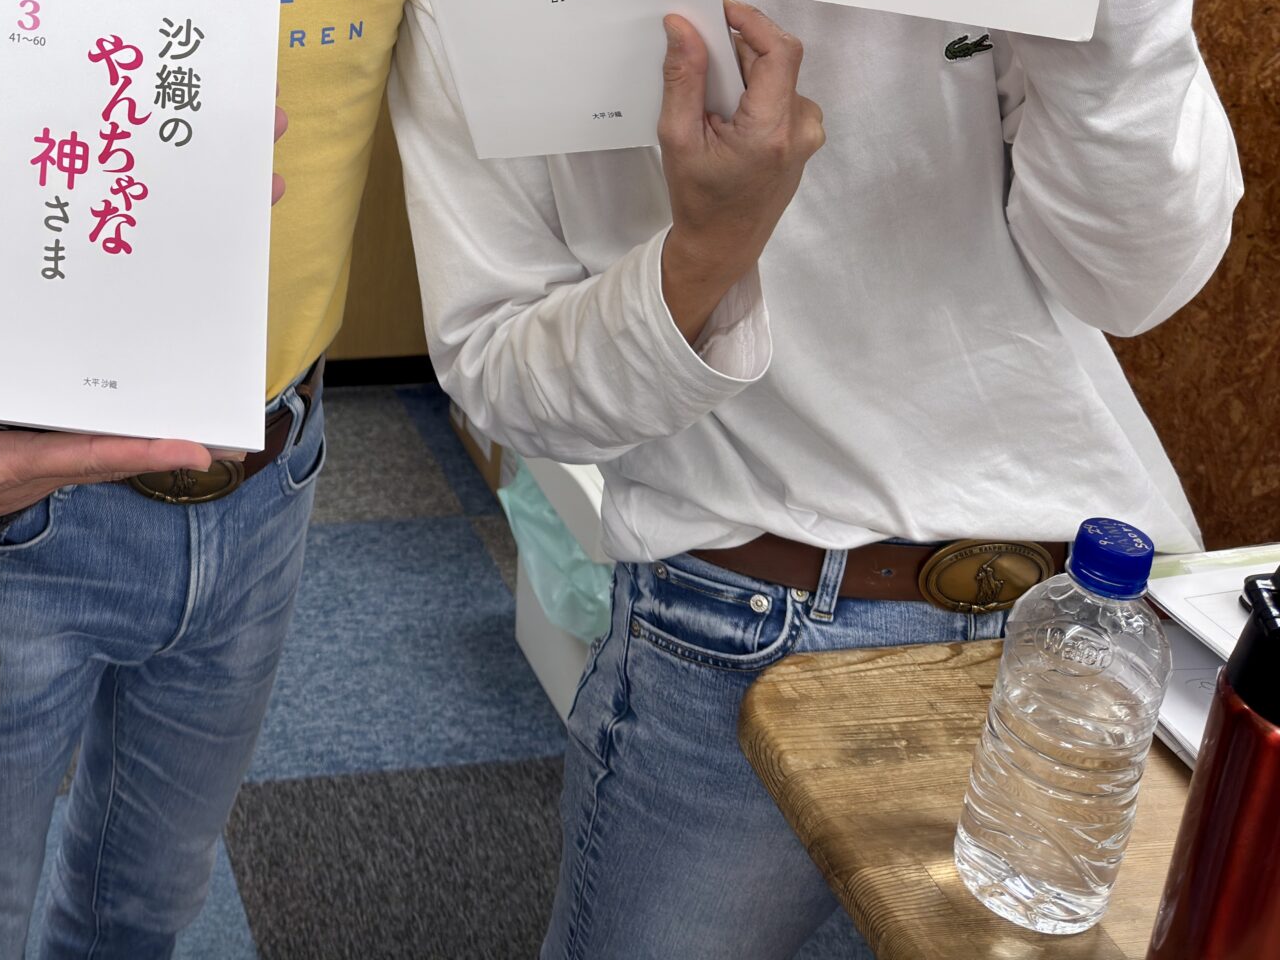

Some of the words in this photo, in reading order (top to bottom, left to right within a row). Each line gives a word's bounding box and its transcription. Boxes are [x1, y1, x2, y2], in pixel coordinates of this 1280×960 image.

[17, 0, 41, 31] 3
[153, 17, 206, 148] 沙織の
[30, 127, 90, 280] 神さま
[87, 34, 153, 255] やんちゃな
